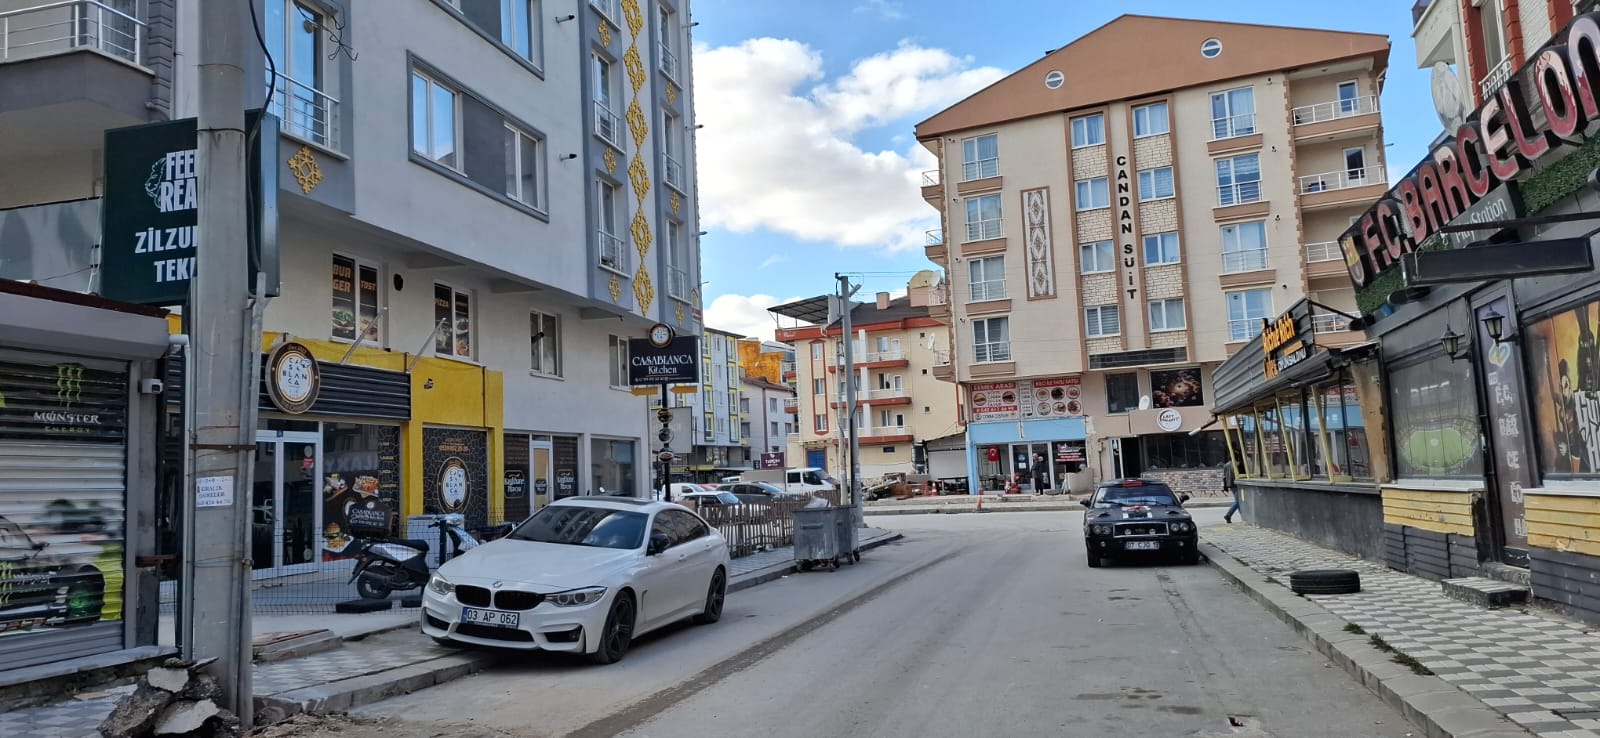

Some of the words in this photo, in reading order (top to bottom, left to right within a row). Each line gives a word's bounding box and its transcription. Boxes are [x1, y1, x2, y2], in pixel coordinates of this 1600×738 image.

[1116, 156, 1132, 234] CANDAN
[333, 264, 351, 278] BUR
[333, 279, 351, 293] GER
[360, 280, 376, 291] TOST
[632, 354, 693, 366] CASABLANCA
[648, 365, 677, 375] Kitchen
[33, 411, 102, 424] MONSTER
[467, 610, 478, 620] 03
[483, 611, 496, 622] AP
[500, 613, 517, 625] 062
